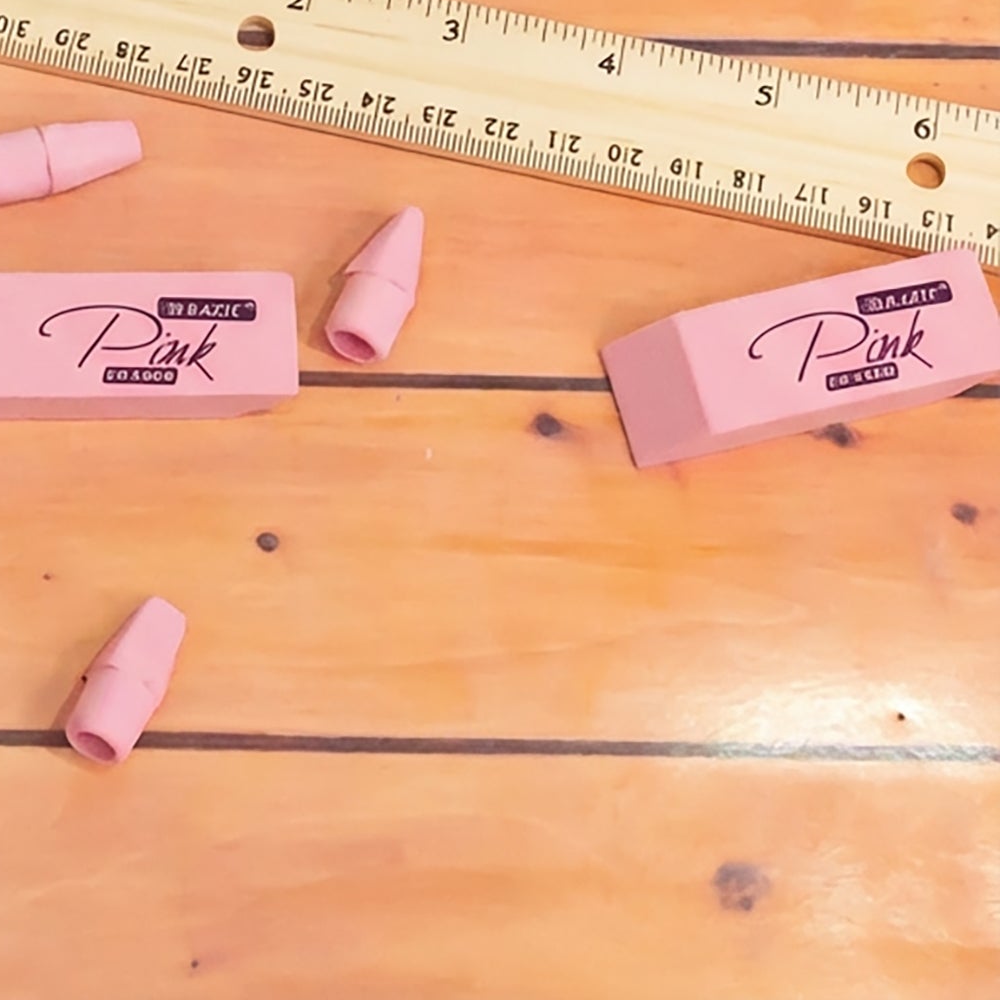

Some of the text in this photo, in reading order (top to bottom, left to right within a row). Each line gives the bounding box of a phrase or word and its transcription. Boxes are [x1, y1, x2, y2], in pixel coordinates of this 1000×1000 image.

[442, 19, 460, 41] 3
[598, 53, 616, 75] 4
[754, 85, 774, 106] 5
[913, 117, 932, 140] 6
[38, 304, 219, 382] Pink
[748, 309, 934, 383] Pink
